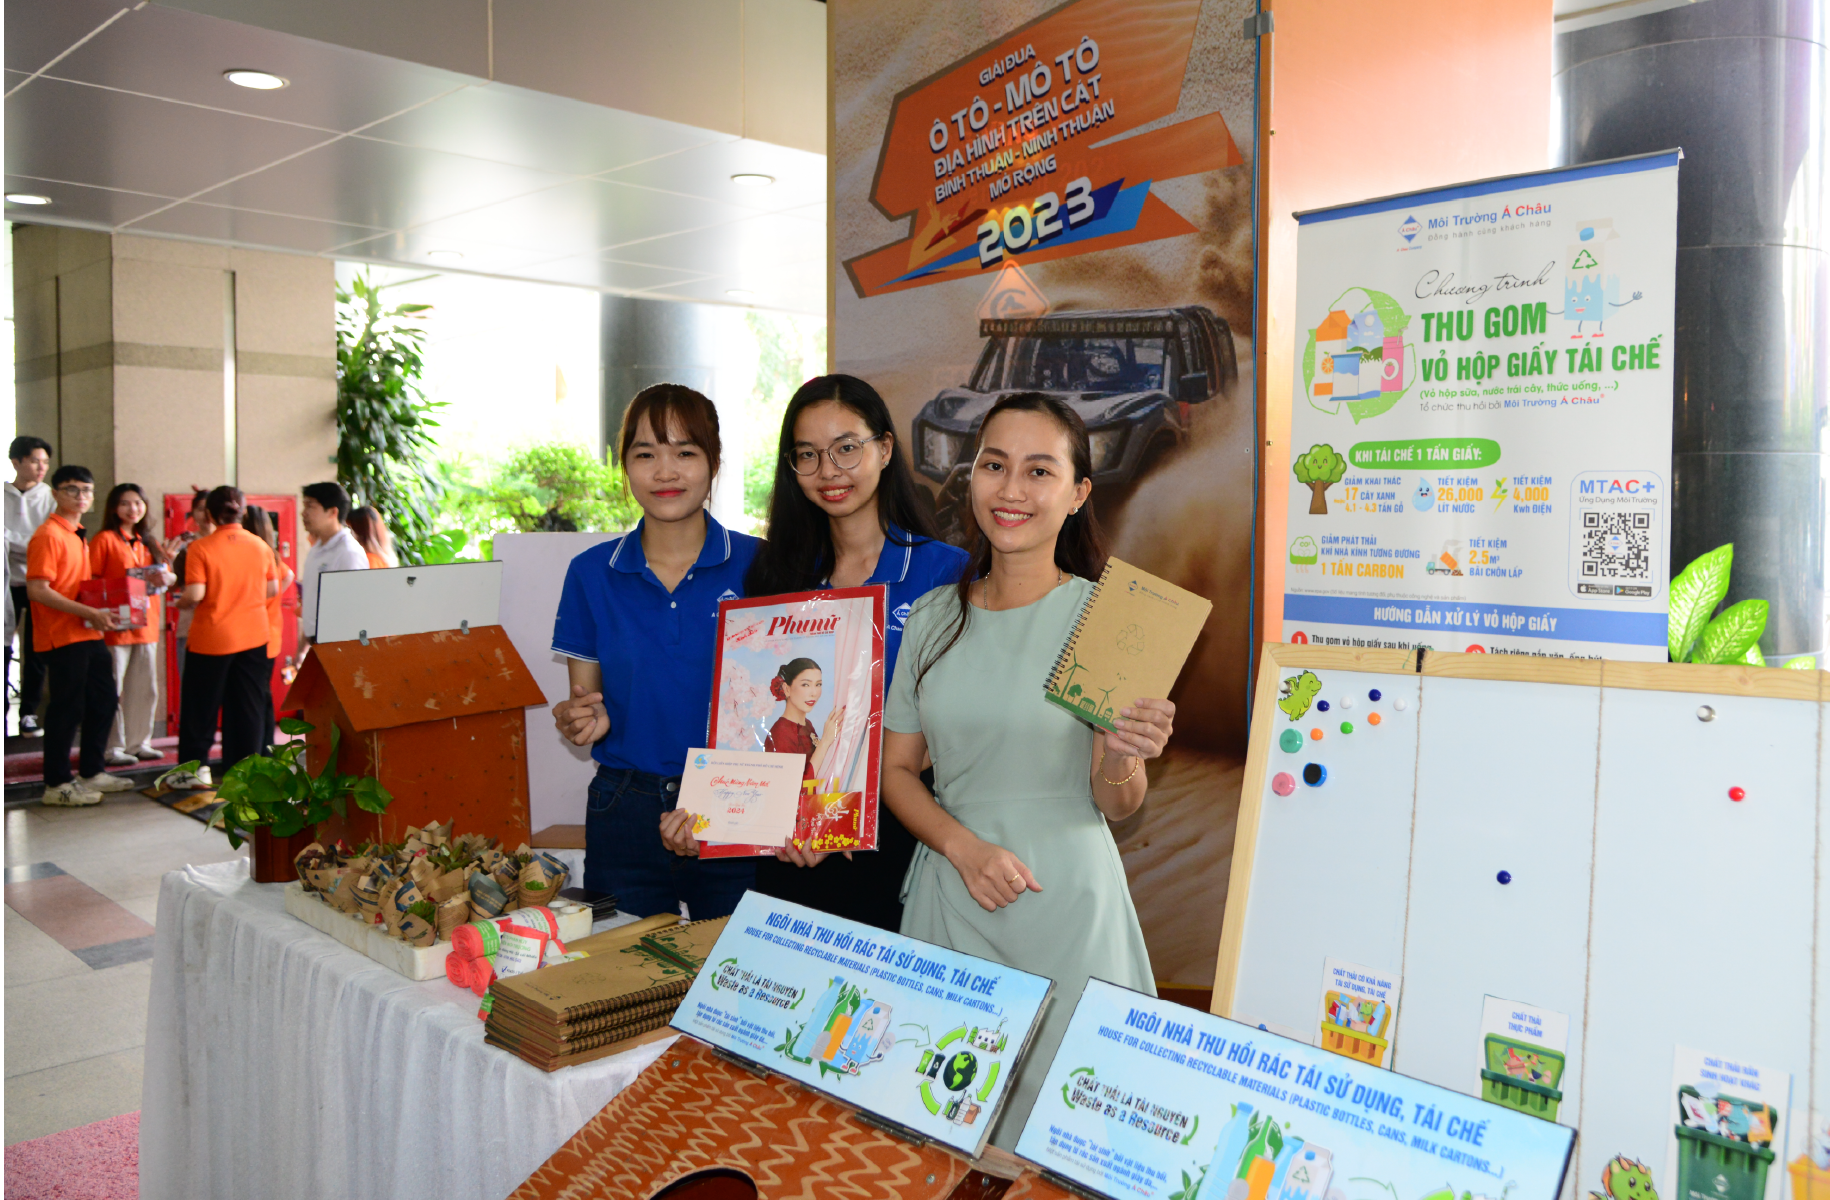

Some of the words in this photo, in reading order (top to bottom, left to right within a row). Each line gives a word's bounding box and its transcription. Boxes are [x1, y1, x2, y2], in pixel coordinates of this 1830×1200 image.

[1005, 44, 1036, 71] ĐUA
[929, 118, 948, 153] Ô
[951, 95, 989, 140] TÔ
[1005, 60, 1052, 113] MÔ
[1055, 35, 1099, 84] TÔ
[934, 149, 965, 180] ĐỊA
[966, 124, 1006, 164] HÌNH
[1007, 97, 1059, 137] TRÊN
[1061, 73, 1102, 113] CÁT
[935, 174, 966, 204] BÌNH
[966, 149, 1013, 183] THUẬN
[1022, 128, 1058, 158] NINH
[1058, 99, 1115, 140] THUẬN
[989, 173, 1011, 201] MỞ
[1012, 154, 1057, 188] RỘNG
[977, 176, 1095, 269] 2023
[1428, 217, 1449, 230] Môi
[1452, 213, 1497, 226] Trường
[1502, 204, 1511, 220] Á
[1515, 203, 1552, 217] Châu
[1428, 232, 1449, 242] Đồng
[1452, 230, 1474, 239] hành
[1477, 227, 1497, 236] cùng
[1501, 222, 1525, 232] khách
[1529, 219, 1552, 228] hàng
[1494, 260, 1556, 291] trình
[1421, 309, 1474, 342] THU
[1484, 302, 1547, 339] GOM
[1421, 350, 1449, 382] VỎ
[1456, 351, 1500, 385] HỘP
[1507, 341, 1559, 377] GIẤY
[1565, 341, 1602, 374] TÁI
[1612, 333, 1663, 371] CHẾ
[1438, 388, 1458, 399] hộp
[1482, 385, 1504, 395] nước
[1506, 384, 1522, 394] trái
[1547, 381, 1569, 392] thức
[1431, 401, 1454, 411] chức
[1457, 401, 1471, 411] thu
[1473, 400, 1487, 410] hồi
[1488, 399, 1502, 410] bởi
[1504, 399, 1519, 408] Môi
[1522, 398, 1557, 408] Trường
[1355, 450, 1373, 463] KHI
[1375, 447, 1391, 462] TÁI
[1393, 444, 1415, 462] CHẾ
[1417, 449, 1422, 461] 1
[1426, 443, 1449, 461] TẤN
[1452, 443, 1482, 461] GIẤY:
[1344, 475, 1363, 486] GIẢM
[1365, 477, 1382, 486] KHAI
[1383, 476, 1402, 485] THÁC
[1438, 475, 1454, 486] TIẾT
[1456, 476, 1478, 487] KIỆM
[1513, 474, 1528, 485] TIẾT
[1530, 476, 1552, 487] KIỆM
[1579, 479, 1656, 495] MTAC+
[1345, 487, 1359, 501] 17
[1360, 490, 1374, 500] CÂY
[1376, 491, 1396, 500] XANH
[1437, 487, 1484, 503] 26,000
[1512, 486, 1550, 503] 4,000
[1345, 502, 1357, 513] 4.1
[1364, 502, 1377, 513] 4.3
[1378, 502, 1393, 513] TẤN
[1438, 503, 1450, 513] LÍT
[1452, 502, 1476, 514] NƯỚC
[1513, 504, 1530, 514] Kwh
[1532, 503, 1552, 515] ĐIỆN
[1321, 533, 1340, 545] GIẢM
[1341, 534, 1359, 545] PHÁT
[1361, 534, 1377, 545] THẢI
[1469, 536, 1485, 548] TIẾT
[1487, 538, 1508, 549] KIỆM
[1321, 562, 1326, 575] 1
[1330, 557, 1353, 577] TẤN
[1356, 562, 1405, 579] CARBON
[1485, 567, 1507, 577] CHÔN
[1508, 567, 1523, 578] LẤP
[1374, 605, 1412, 623] HƯỚNG
[1415, 604, 1441, 625] DẪN
[1445, 607, 1464, 626] XỬ
[1465, 609, 1480, 626] LÝ
[1483, 608, 1499, 628] VỎ
[1502, 612, 1526, 632] HỘP
[1528, 611, 1558, 632] GIẤY
[1312, 634, 1324, 644] Thu
[1325, 637, 1341, 646] gom
[765, 911, 792, 931] NGÔI
[790, 919, 814, 938] NHÀ
[812, 926, 835, 944] THU
[833, 930, 854, 951] HỒI
[852, 938, 878, 958] RÁC
[876, 945, 897, 965] TÁI
[895, 949, 916, 970] SỬ
[911, 956, 947, 983] DỤNG,
[949, 967, 972, 988] TÁI
[970, 976, 1002, 997] CHẾ
[717, 974, 739, 992] Waste
[738, 984, 750, 995] as
[748, 987, 756, 998] a
[754, 988, 791, 1009] Resource
[1511, 1011, 1527, 1023] CHẤT
[1524, 1024, 1543, 1038] PHẨM
[1124, 1007, 1162, 1035] NGÔI
[1161, 1019, 1194, 1046] NHÀ
[1195, 1031, 1227, 1057] THU
[1226, 1041, 1257, 1068] HỒI
[1256, 1052, 1292, 1080] RÁC
[1294, 1063, 1323, 1091] TÁI
[1323, 1072, 1353, 1100] SỬ
[1351, 1083, 1405, 1123] DỤNG,
[1412, 1102, 1443, 1132] TÁI
[1445, 1118, 1492, 1147] CHẾ
[1097, 1025, 1124, 1043] HOUSE
[1123, 1033, 1139, 1049] FOR
[1139, 1039, 1187, 1066] COLLECTING
[1186, 1056, 1239, 1084] RECYCLABLE
[1238, 1074, 1289, 1101] MATERIALS
[1288, 1092, 1331, 1118] (PLASTIC
[1331, 1108, 1375, 1135] BOTTLES,
[1377, 1123, 1408, 1146] CANS,
[1410, 1135, 1438, 1156] MILK
[1076, 1075, 1100, 1093] CHẤT
[1120, 1091, 1134, 1107] LÀ
[1149, 1102, 1189, 1129] NGUYÊN
[1071, 1087, 1103, 1112] Waste
[1103, 1103, 1118, 1118] as
[1118, 1109, 1127, 1122] a
[1128, 1111, 1180, 1144] Resource
